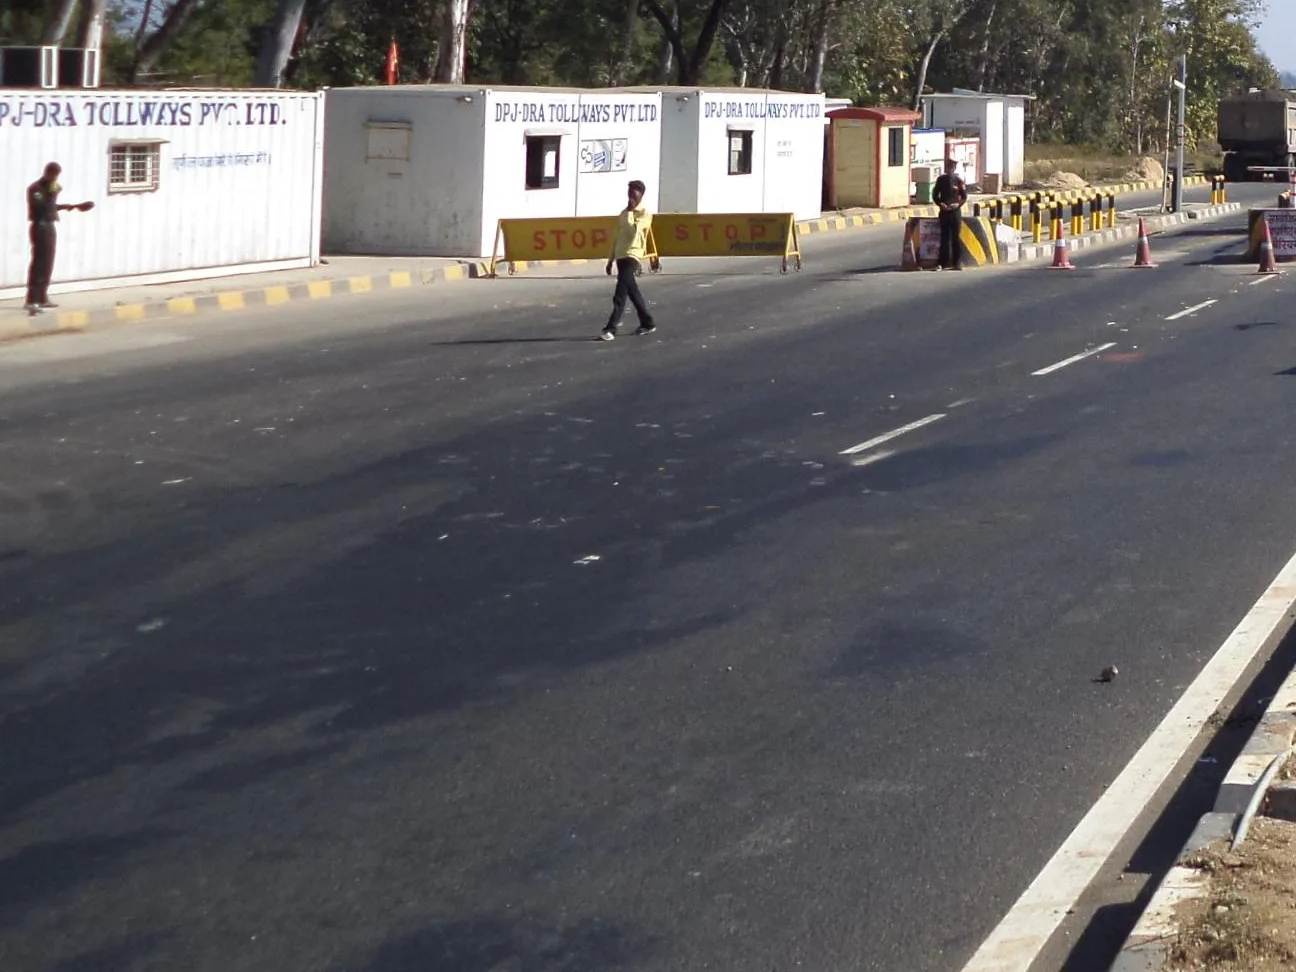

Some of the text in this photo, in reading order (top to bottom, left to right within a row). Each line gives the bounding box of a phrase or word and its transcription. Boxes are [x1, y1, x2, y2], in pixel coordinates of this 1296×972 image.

[84, 101, 192, 126] TOLLWAYS
[245, 102, 287, 126] LTD.
[494, 103, 545, 123] DPJ-DRA
[704, 101, 743, 119] DPJ-DRA
[533, 228, 608, 251] STOP
[675, 223, 766, 241] STOP
